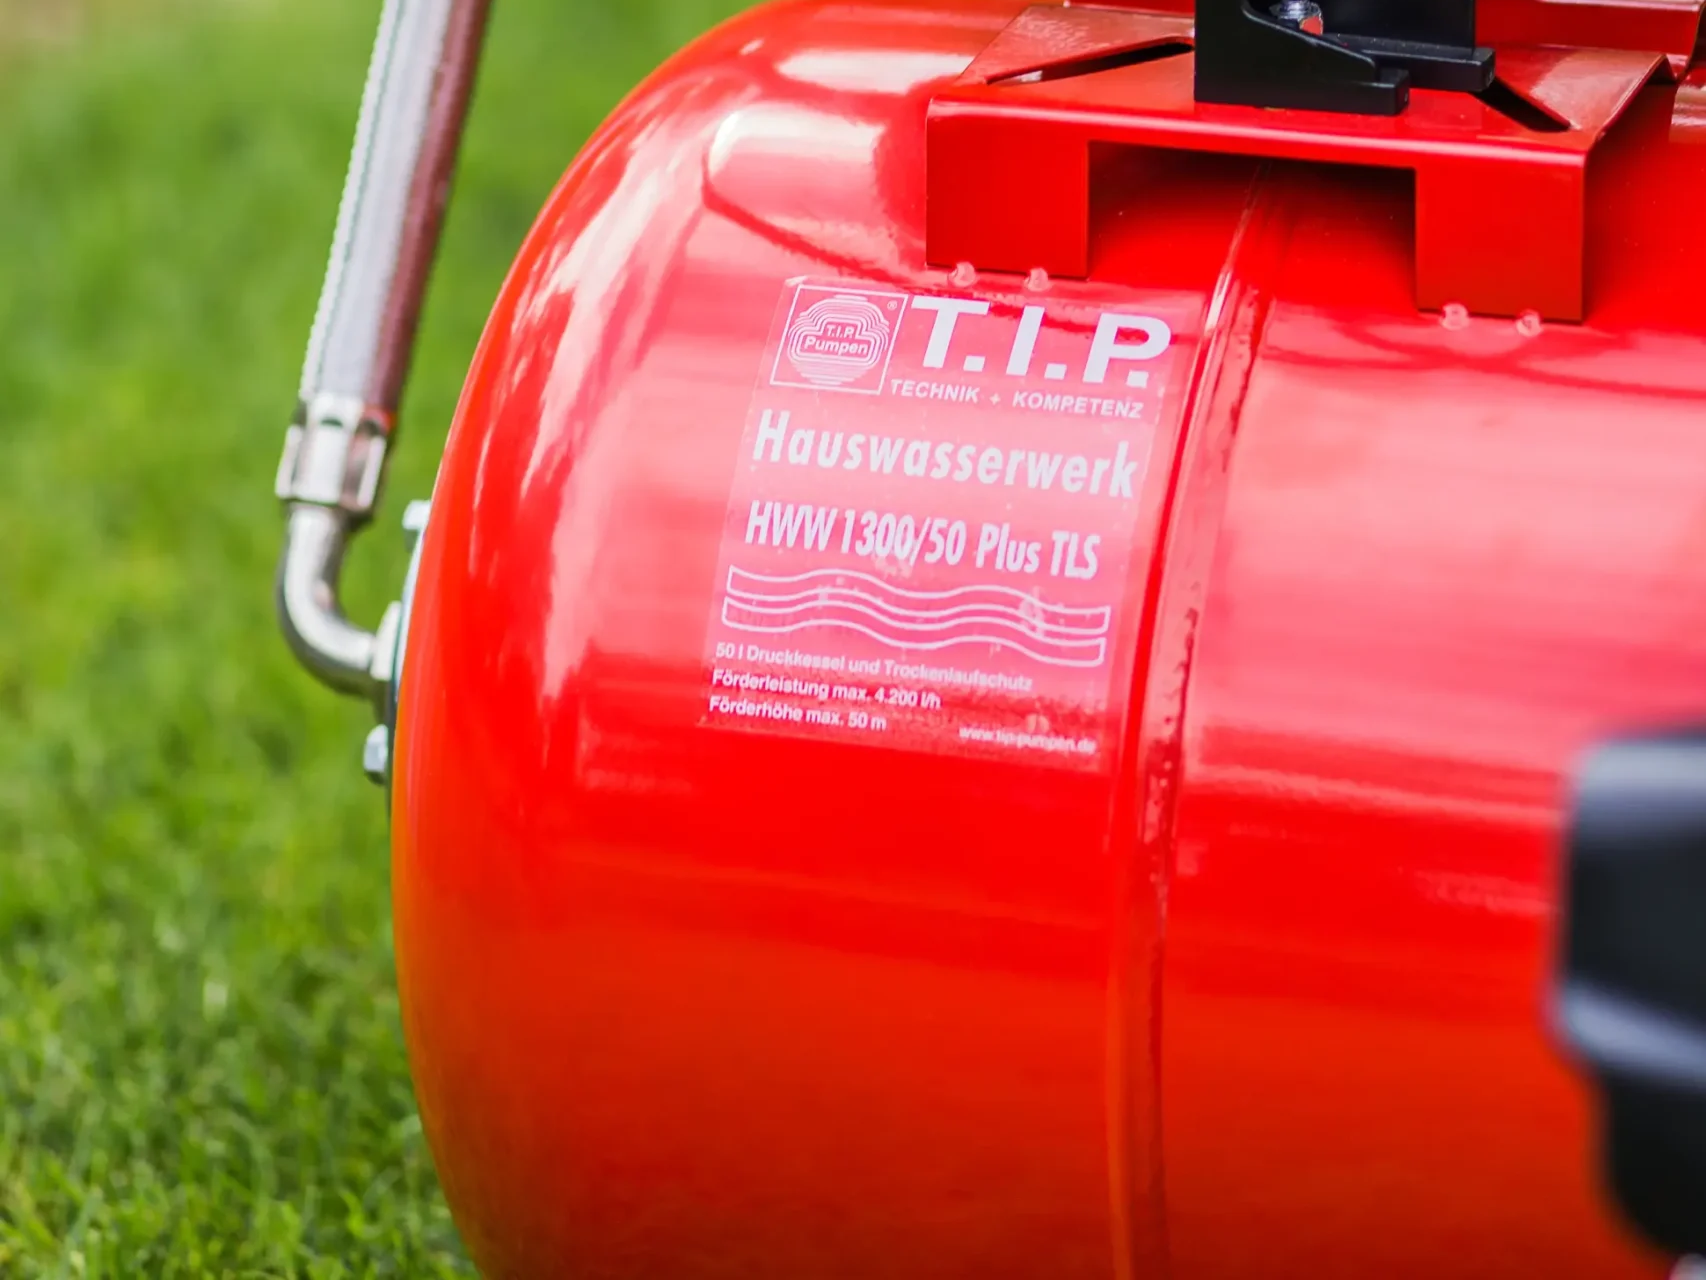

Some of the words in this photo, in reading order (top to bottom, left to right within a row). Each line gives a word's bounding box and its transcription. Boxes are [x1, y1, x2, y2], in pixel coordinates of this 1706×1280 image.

[804, 335, 868, 356] Pumpen
[911, 295, 1172, 388] T.I.P.
[890, 378, 981, 404] TECHNIK
[1012, 390, 1144, 419] KOMPETENZ
[751, 408, 1139, 499] Hauswasserwerk
[744, 499, 838, 552] HWW
[840, 508, 967, 568] 1300/50
[976, 522, 1042, 575] Plus
[1050, 530, 1101, 581] TLS
[712, 668, 829, 700] Förderleistung
[832, 684, 871, 701] max.
[874, 687, 918, 706] 4.200
[715, 641, 735, 659] 50
[746, 644, 845, 670] Druckkessel
[848, 658, 880, 676] und
[884, 659, 1033, 692] Trockenlaufschutz
[709, 695, 803, 721] Förderhöhe
[806, 708, 844, 726] max.
[848, 711, 868, 729] 50
[870, 717, 887, 731] m
